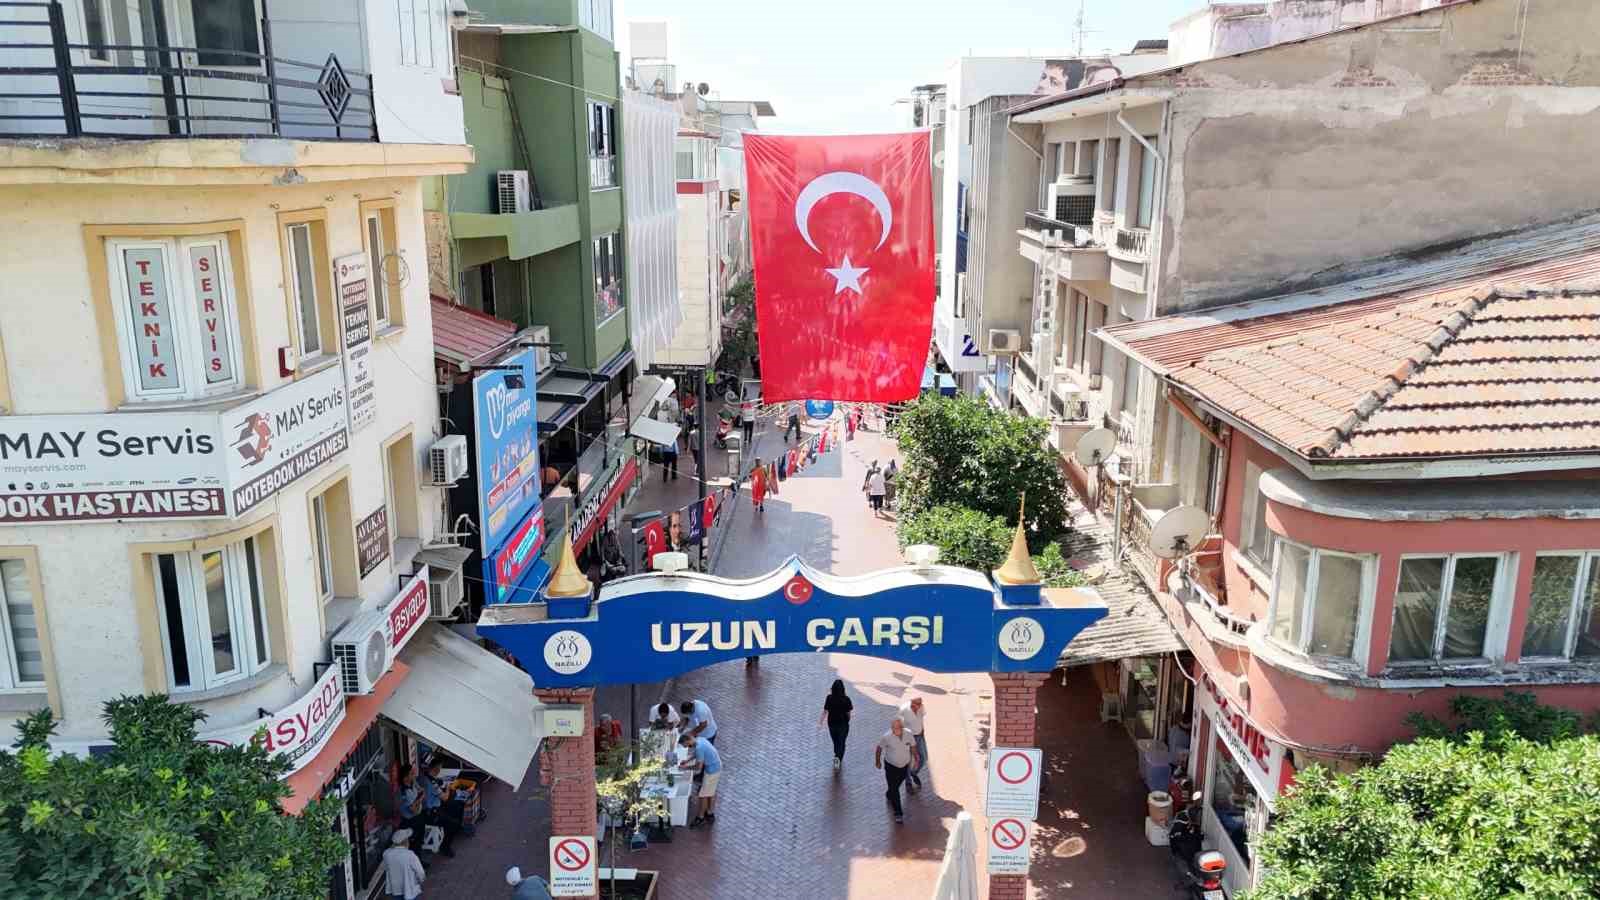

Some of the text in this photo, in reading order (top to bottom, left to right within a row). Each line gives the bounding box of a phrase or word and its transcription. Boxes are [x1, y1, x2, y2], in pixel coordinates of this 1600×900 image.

[136, 260, 167, 377] TEKNİK
[199, 257, 222, 371] SERVİS
[276, 403, 305, 436] MAY
[308, 386, 343, 420] Servis
[0, 428, 214, 459] MAY Servis
[235, 463, 297, 512] NOTEBOOK
[295, 430, 347, 475] HASTANESİ
[53, 490, 220, 516] HASTANESİ
[651, 615, 944, 653] UZUN ÇARŞI
